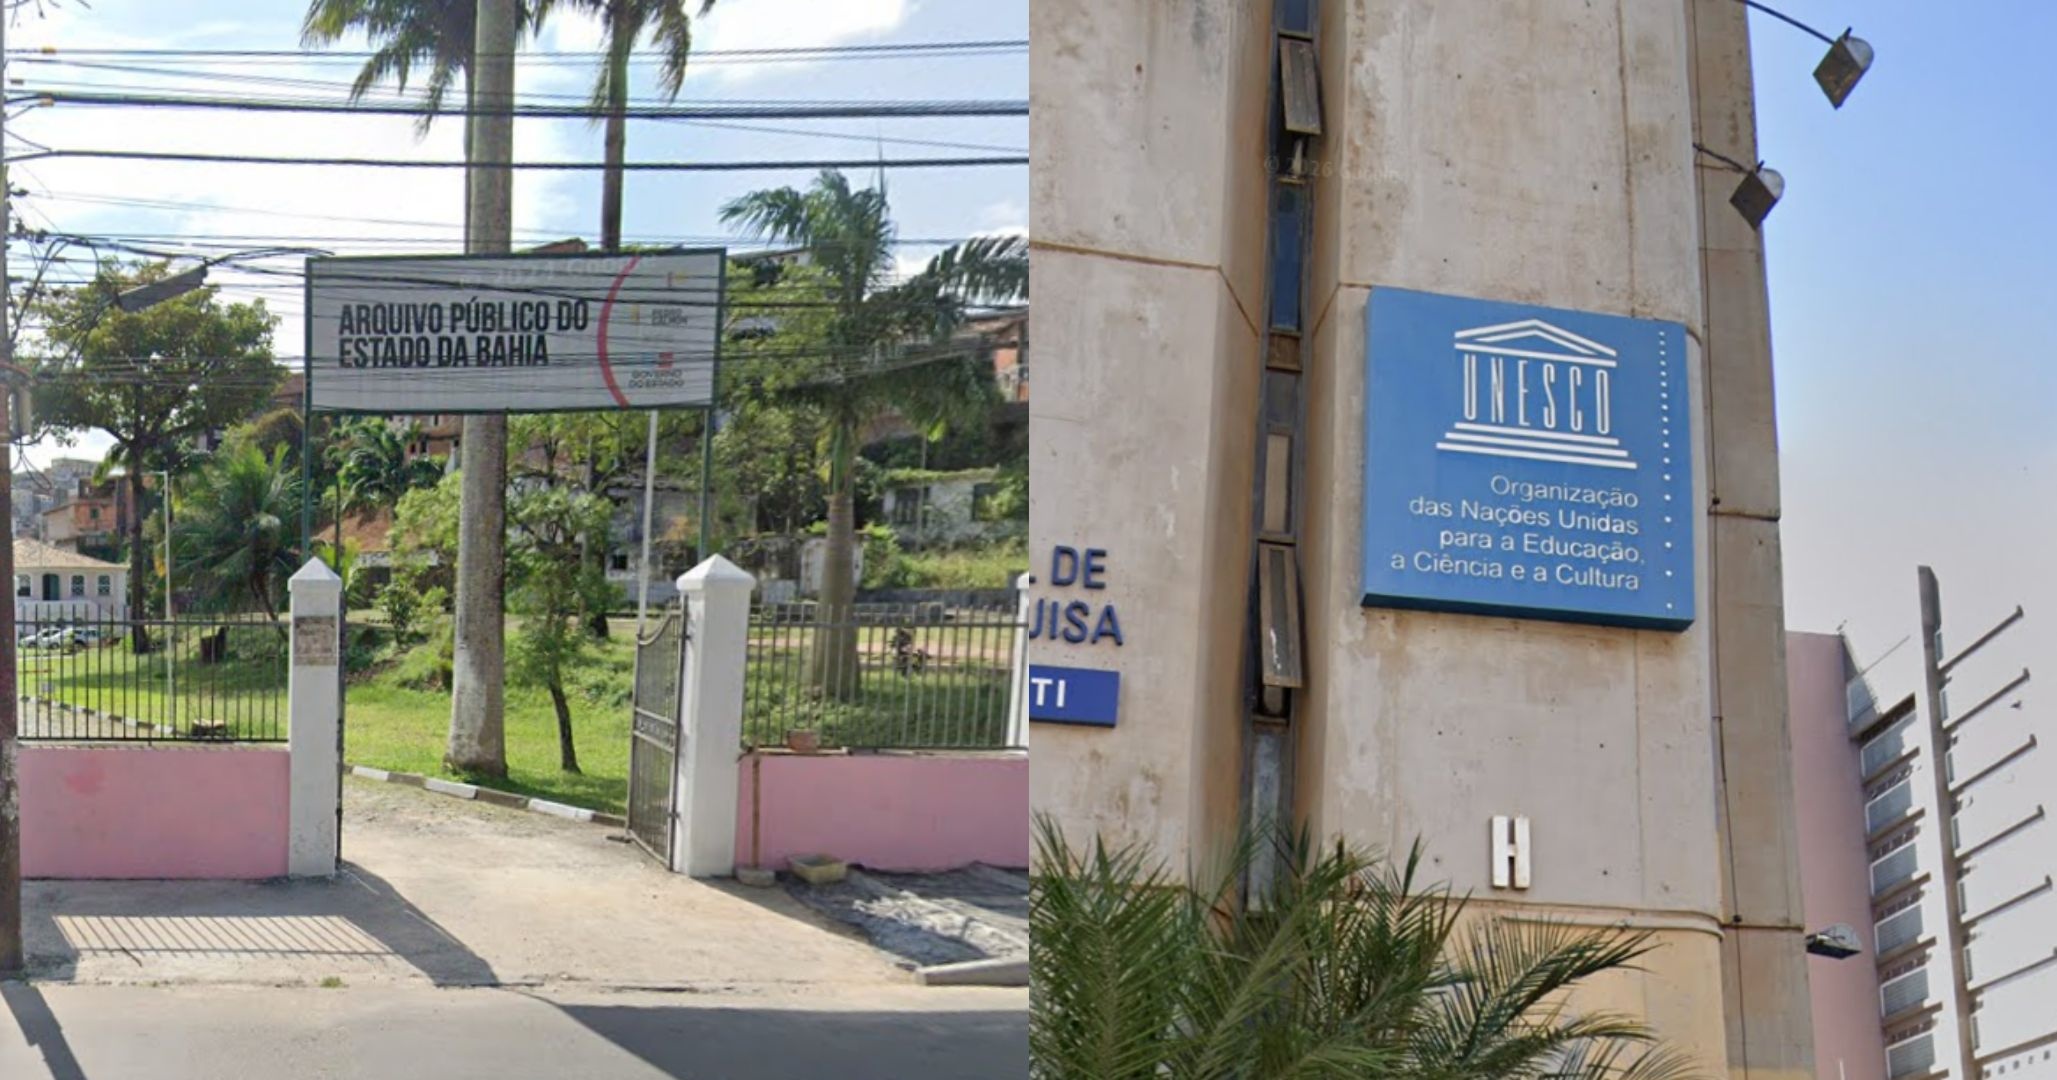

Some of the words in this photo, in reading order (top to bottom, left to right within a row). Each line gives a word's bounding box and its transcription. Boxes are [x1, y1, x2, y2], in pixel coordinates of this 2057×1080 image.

[339, 302, 443, 336] ARQUIVO
[450, 296, 550, 333] PÚBLICO
[556, 300, 589, 331] DO
[339, 335, 430, 368] ESTADO
[438, 335, 468, 367] DA
[476, 334, 550, 367] BAHIA
[1464, 354, 1610, 434] UNESCO
[1490, 474, 1639, 510] Organização
[1408, 496, 1453, 518] das
[1461, 499, 1550, 527] Nações
[1558, 509, 1639, 535] Unidas
[1440, 530, 1492, 550] para
[1500, 534, 1514, 551] a
[1523, 533, 1645, 565] Educação,
[1052, 545, 1107, 590] DE
[1391, 553, 1405, 570] a
[1413, 551, 1503, 579] Ciência
[1511, 563, 1525, 580] e
[1533, 565, 1547, 582] a
[1555, 563, 1639, 591] Cultura
[1030, 677, 1066, 708] TI
[1491, 814, 1530, 889] H
